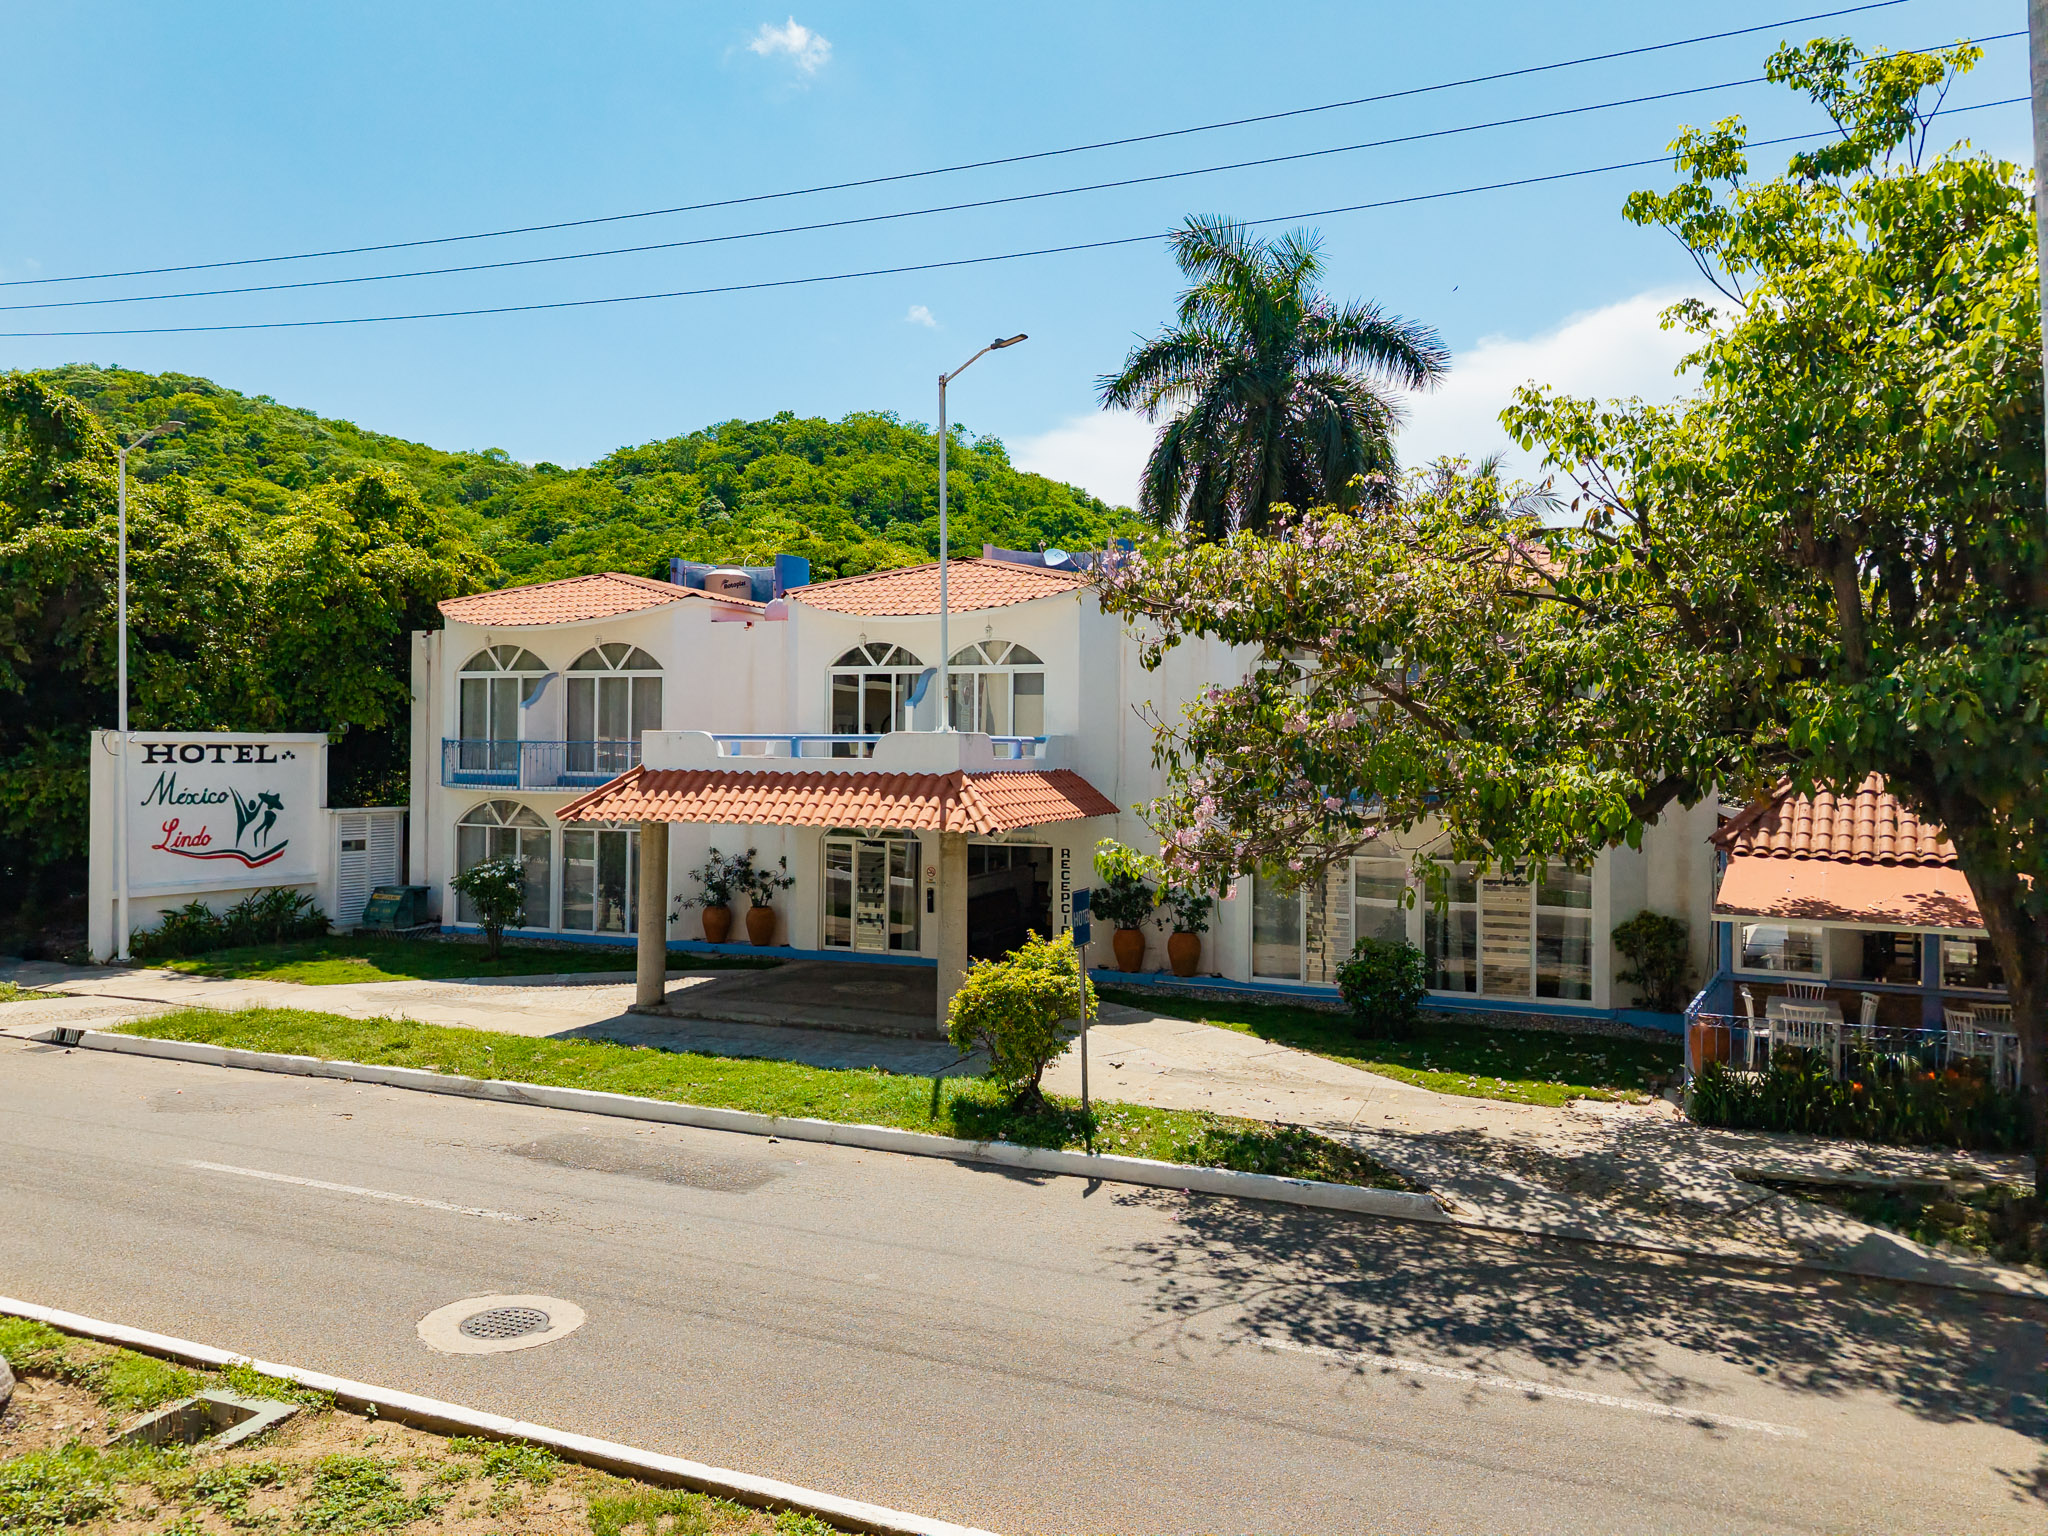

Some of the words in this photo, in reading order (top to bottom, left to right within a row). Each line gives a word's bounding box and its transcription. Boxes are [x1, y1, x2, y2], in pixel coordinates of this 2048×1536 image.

[141, 743, 278, 764] HOTEL
[140, 770, 229, 806] México
[151, 817, 213, 850] Lindo
